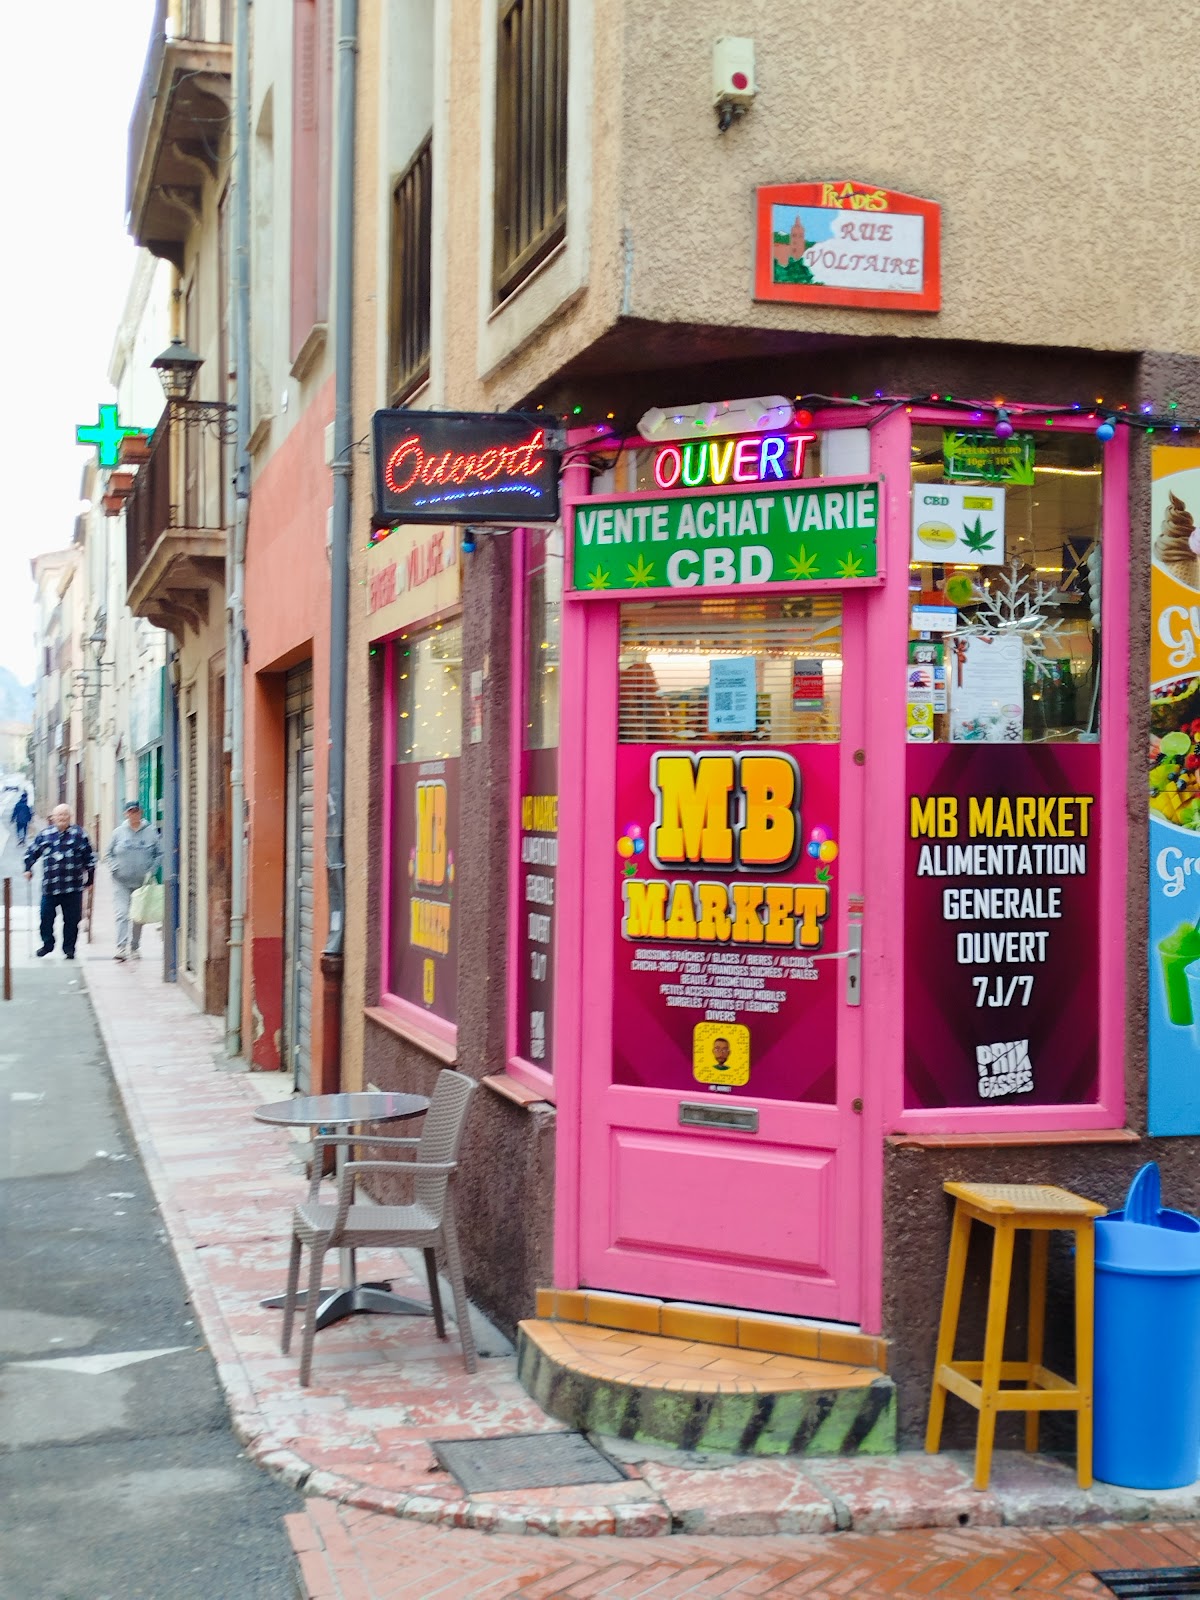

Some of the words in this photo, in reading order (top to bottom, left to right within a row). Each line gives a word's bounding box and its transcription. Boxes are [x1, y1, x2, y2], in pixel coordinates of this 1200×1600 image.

[821, 182, 889, 210] PRADES
[841, 221, 894, 242] RUE
[806, 250, 920, 275] VOLTAIRE
[385, 429, 544, 494] Ouvert
[653, 431, 817, 490] OUVERT
[923, 495, 950, 506] CBD
[577, 504, 669, 546] VENTE
[676, 498, 775, 540] ACHAT
[666, 545, 775, 589] CBD
[651, 752, 800, 872] MB
[910, 797, 959, 838] MB
[968, 797, 1094, 838] MARKET
[917, 844, 1087, 877] ALIMENTATION
[622, 879, 830, 949] MARKET
[943, 888, 1062, 921] GENERALE
[957, 931, 1050, 964] OUVERT
[733, 988, 754, 1000] POUR
[972, 975, 1035, 1008] 7J/7
[705, 1009, 736, 1022] DIVERS
[975, 1039, 1033, 1077] PRIX
